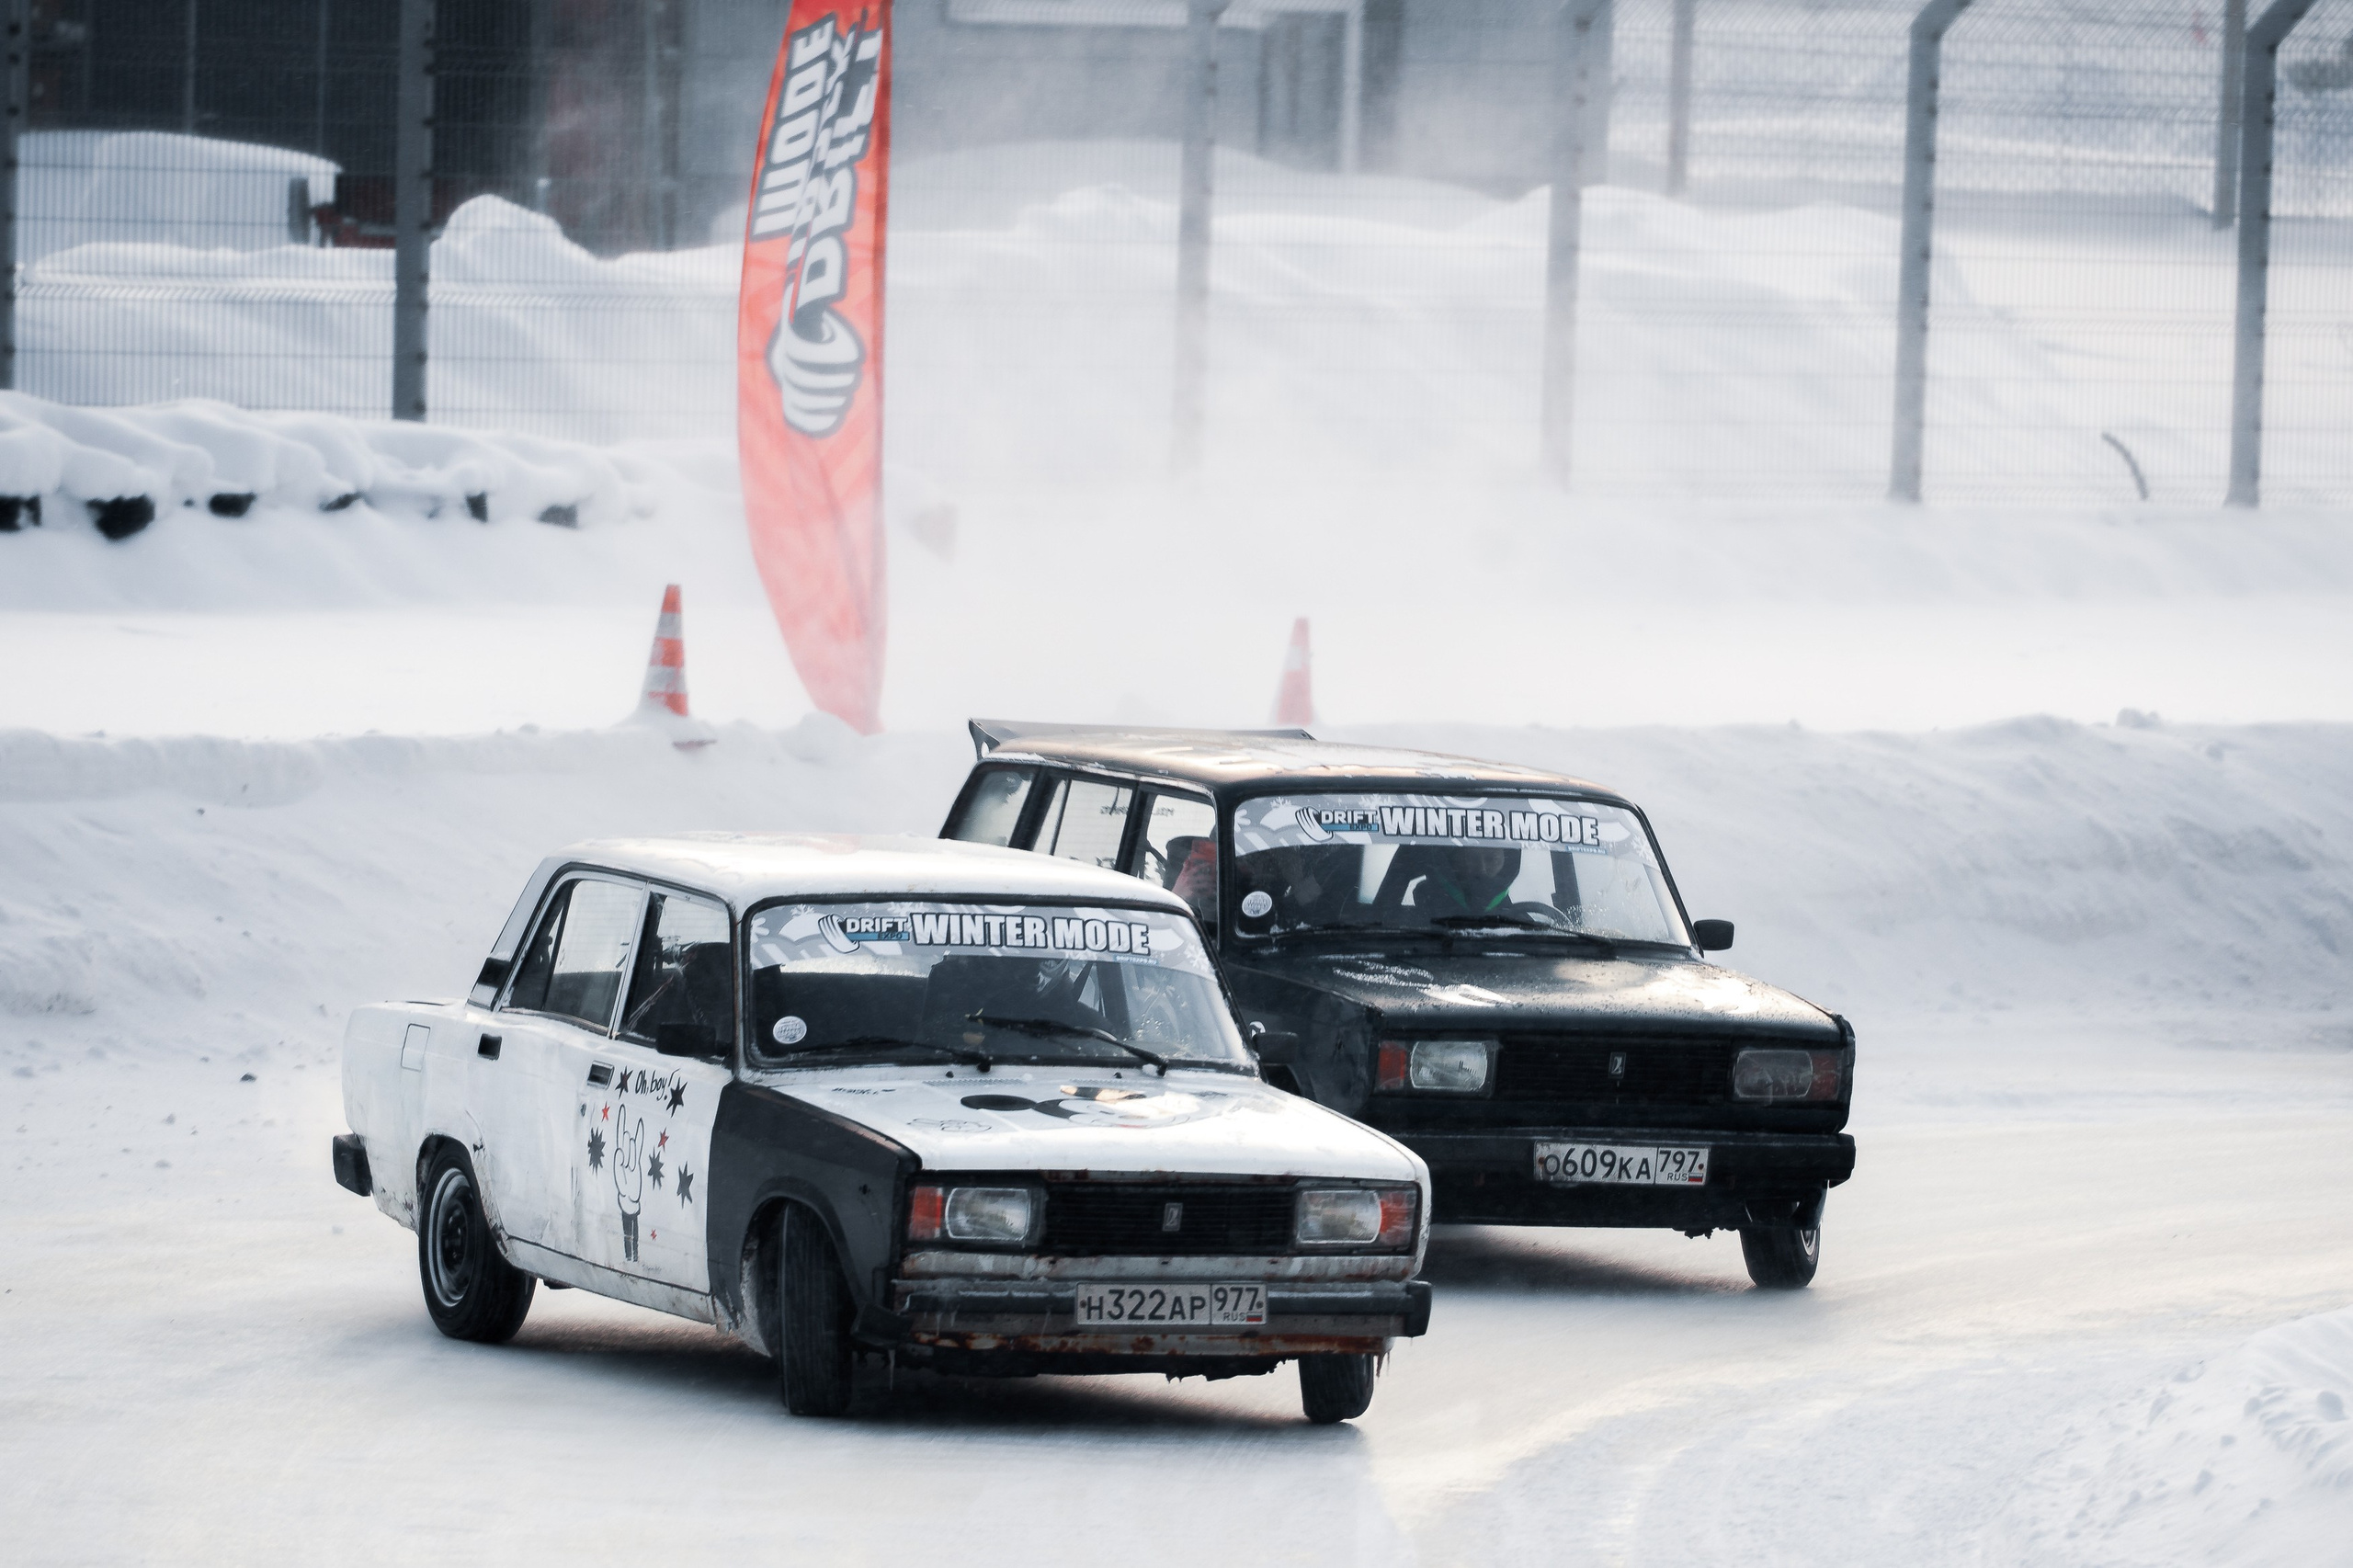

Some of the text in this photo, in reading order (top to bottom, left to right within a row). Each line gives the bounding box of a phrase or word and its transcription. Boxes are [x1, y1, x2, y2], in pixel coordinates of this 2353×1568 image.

[1321, 810, 1377, 824] DRIFT
[1380, 807, 1599, 846] WINTER MODE
[846, 917, 908, 932] DRIFT
[911, 914, 1150, 955] WINTER MODE
[635, 1068, 681, 1101] Oh, boy!
[1659, 1150, 1699, 1173] 797
[1667, 1173, 1688, 1181] RUS
[1214, 1288, 1259, 1312] 977
[1223, 1312, 1245, 1322] RUS
